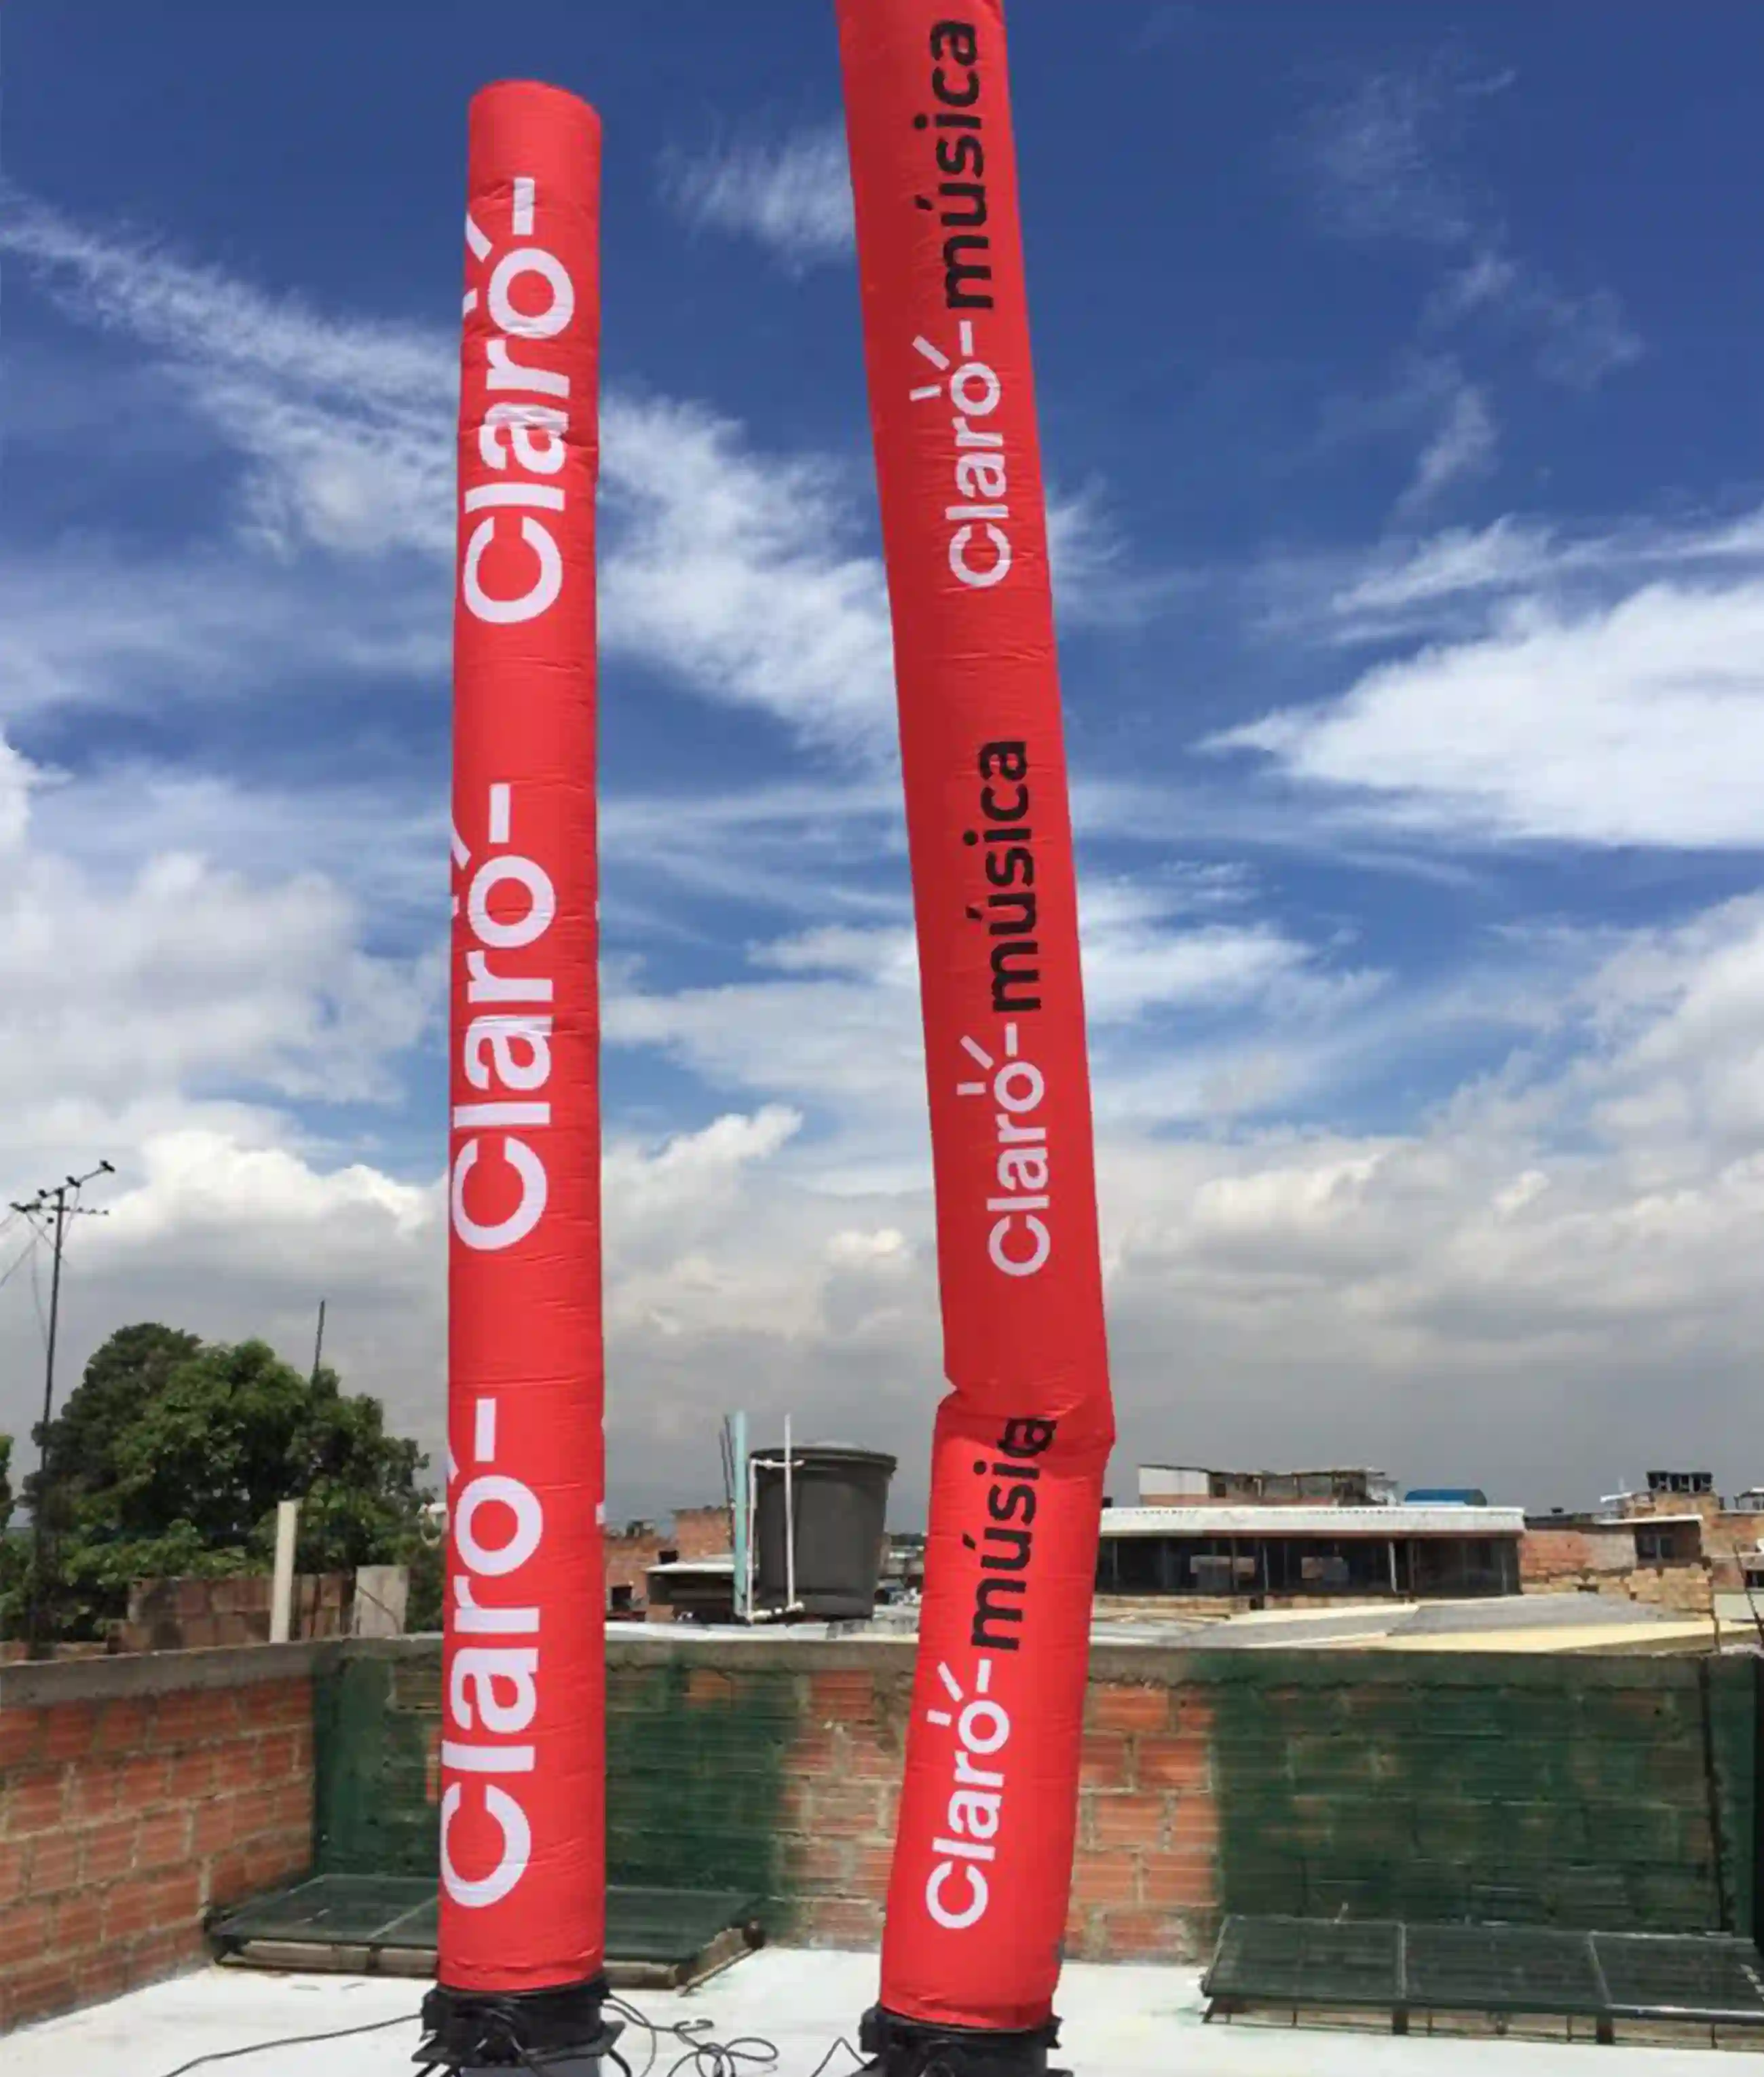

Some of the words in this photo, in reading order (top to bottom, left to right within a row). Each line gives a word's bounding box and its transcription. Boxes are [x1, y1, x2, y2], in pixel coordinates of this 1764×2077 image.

[912, 20, 994, 310] música
[462, 246, 575, 624] Claro
[946, 361, 1013, 588] Claro
[962, 741, 1042, 1013] música
[449, 854, 557, 1252] Claro
[986, 1061, 1051, 1276] Claro
[440, 1474, 544, 1909] Claro
[924, 1699, 1011, 1930] Claro
